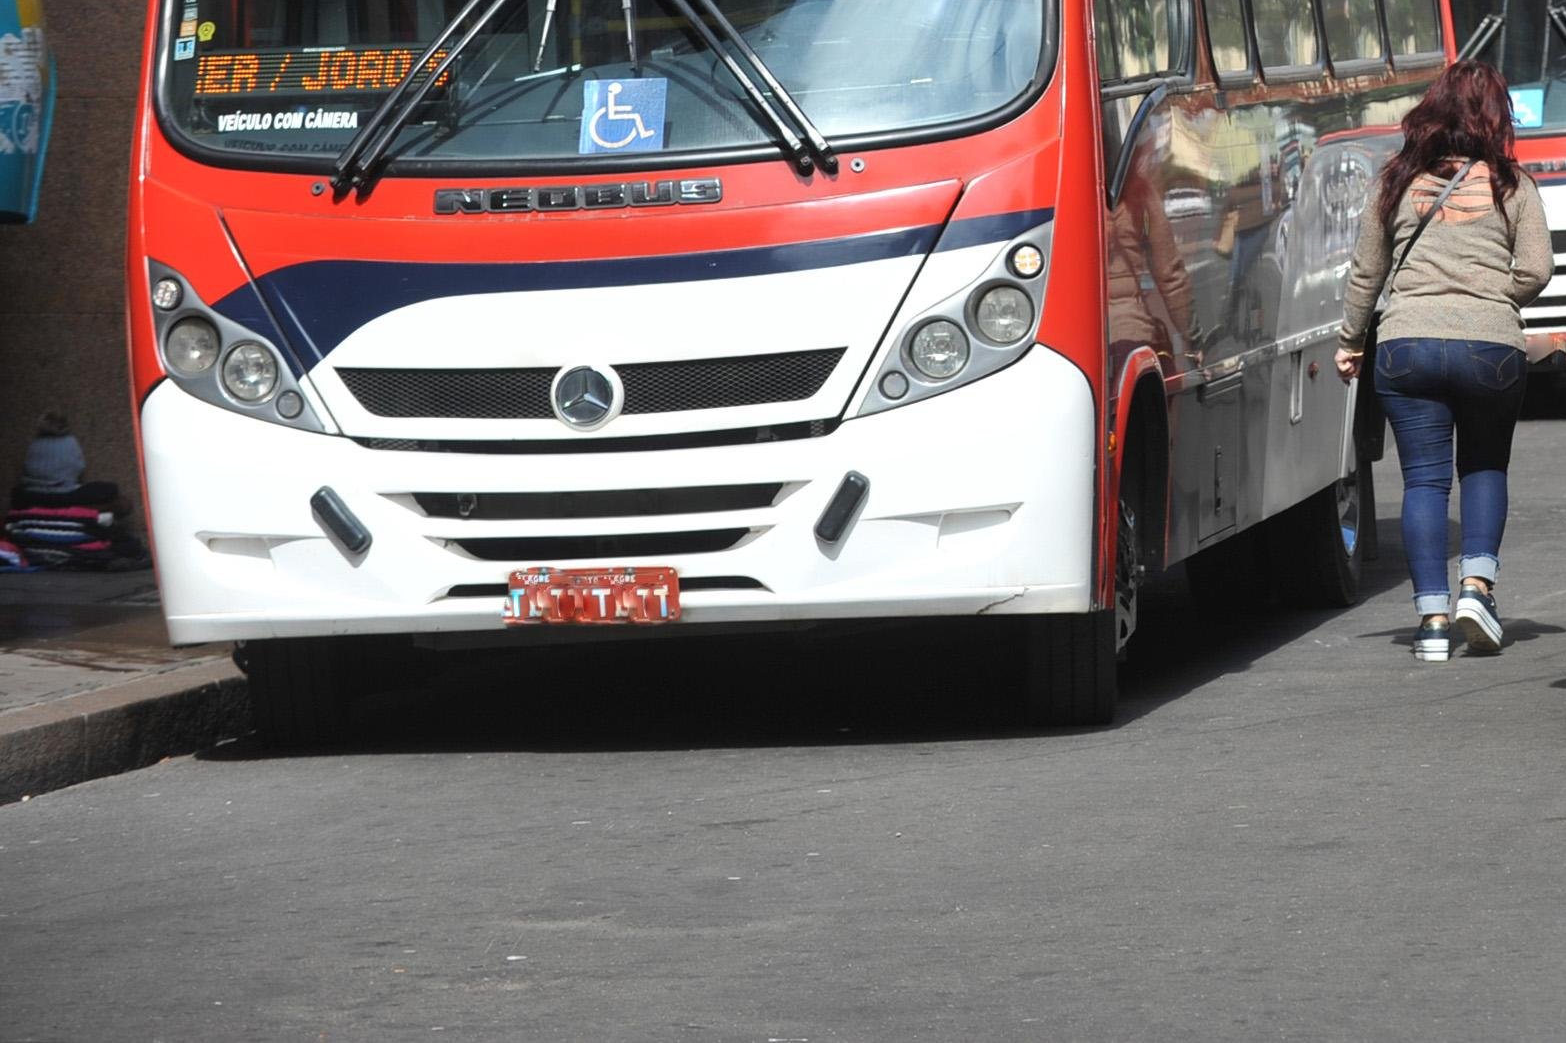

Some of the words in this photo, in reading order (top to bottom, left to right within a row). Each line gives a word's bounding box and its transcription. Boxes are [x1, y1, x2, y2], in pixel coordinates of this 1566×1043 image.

[217, 110, 273, 132] VEÍCULO
[273, 112, 304, 130] COM
[304, 107, 358, 129] CÂMERA
[434, 177, 722, 214] NEOBUS
